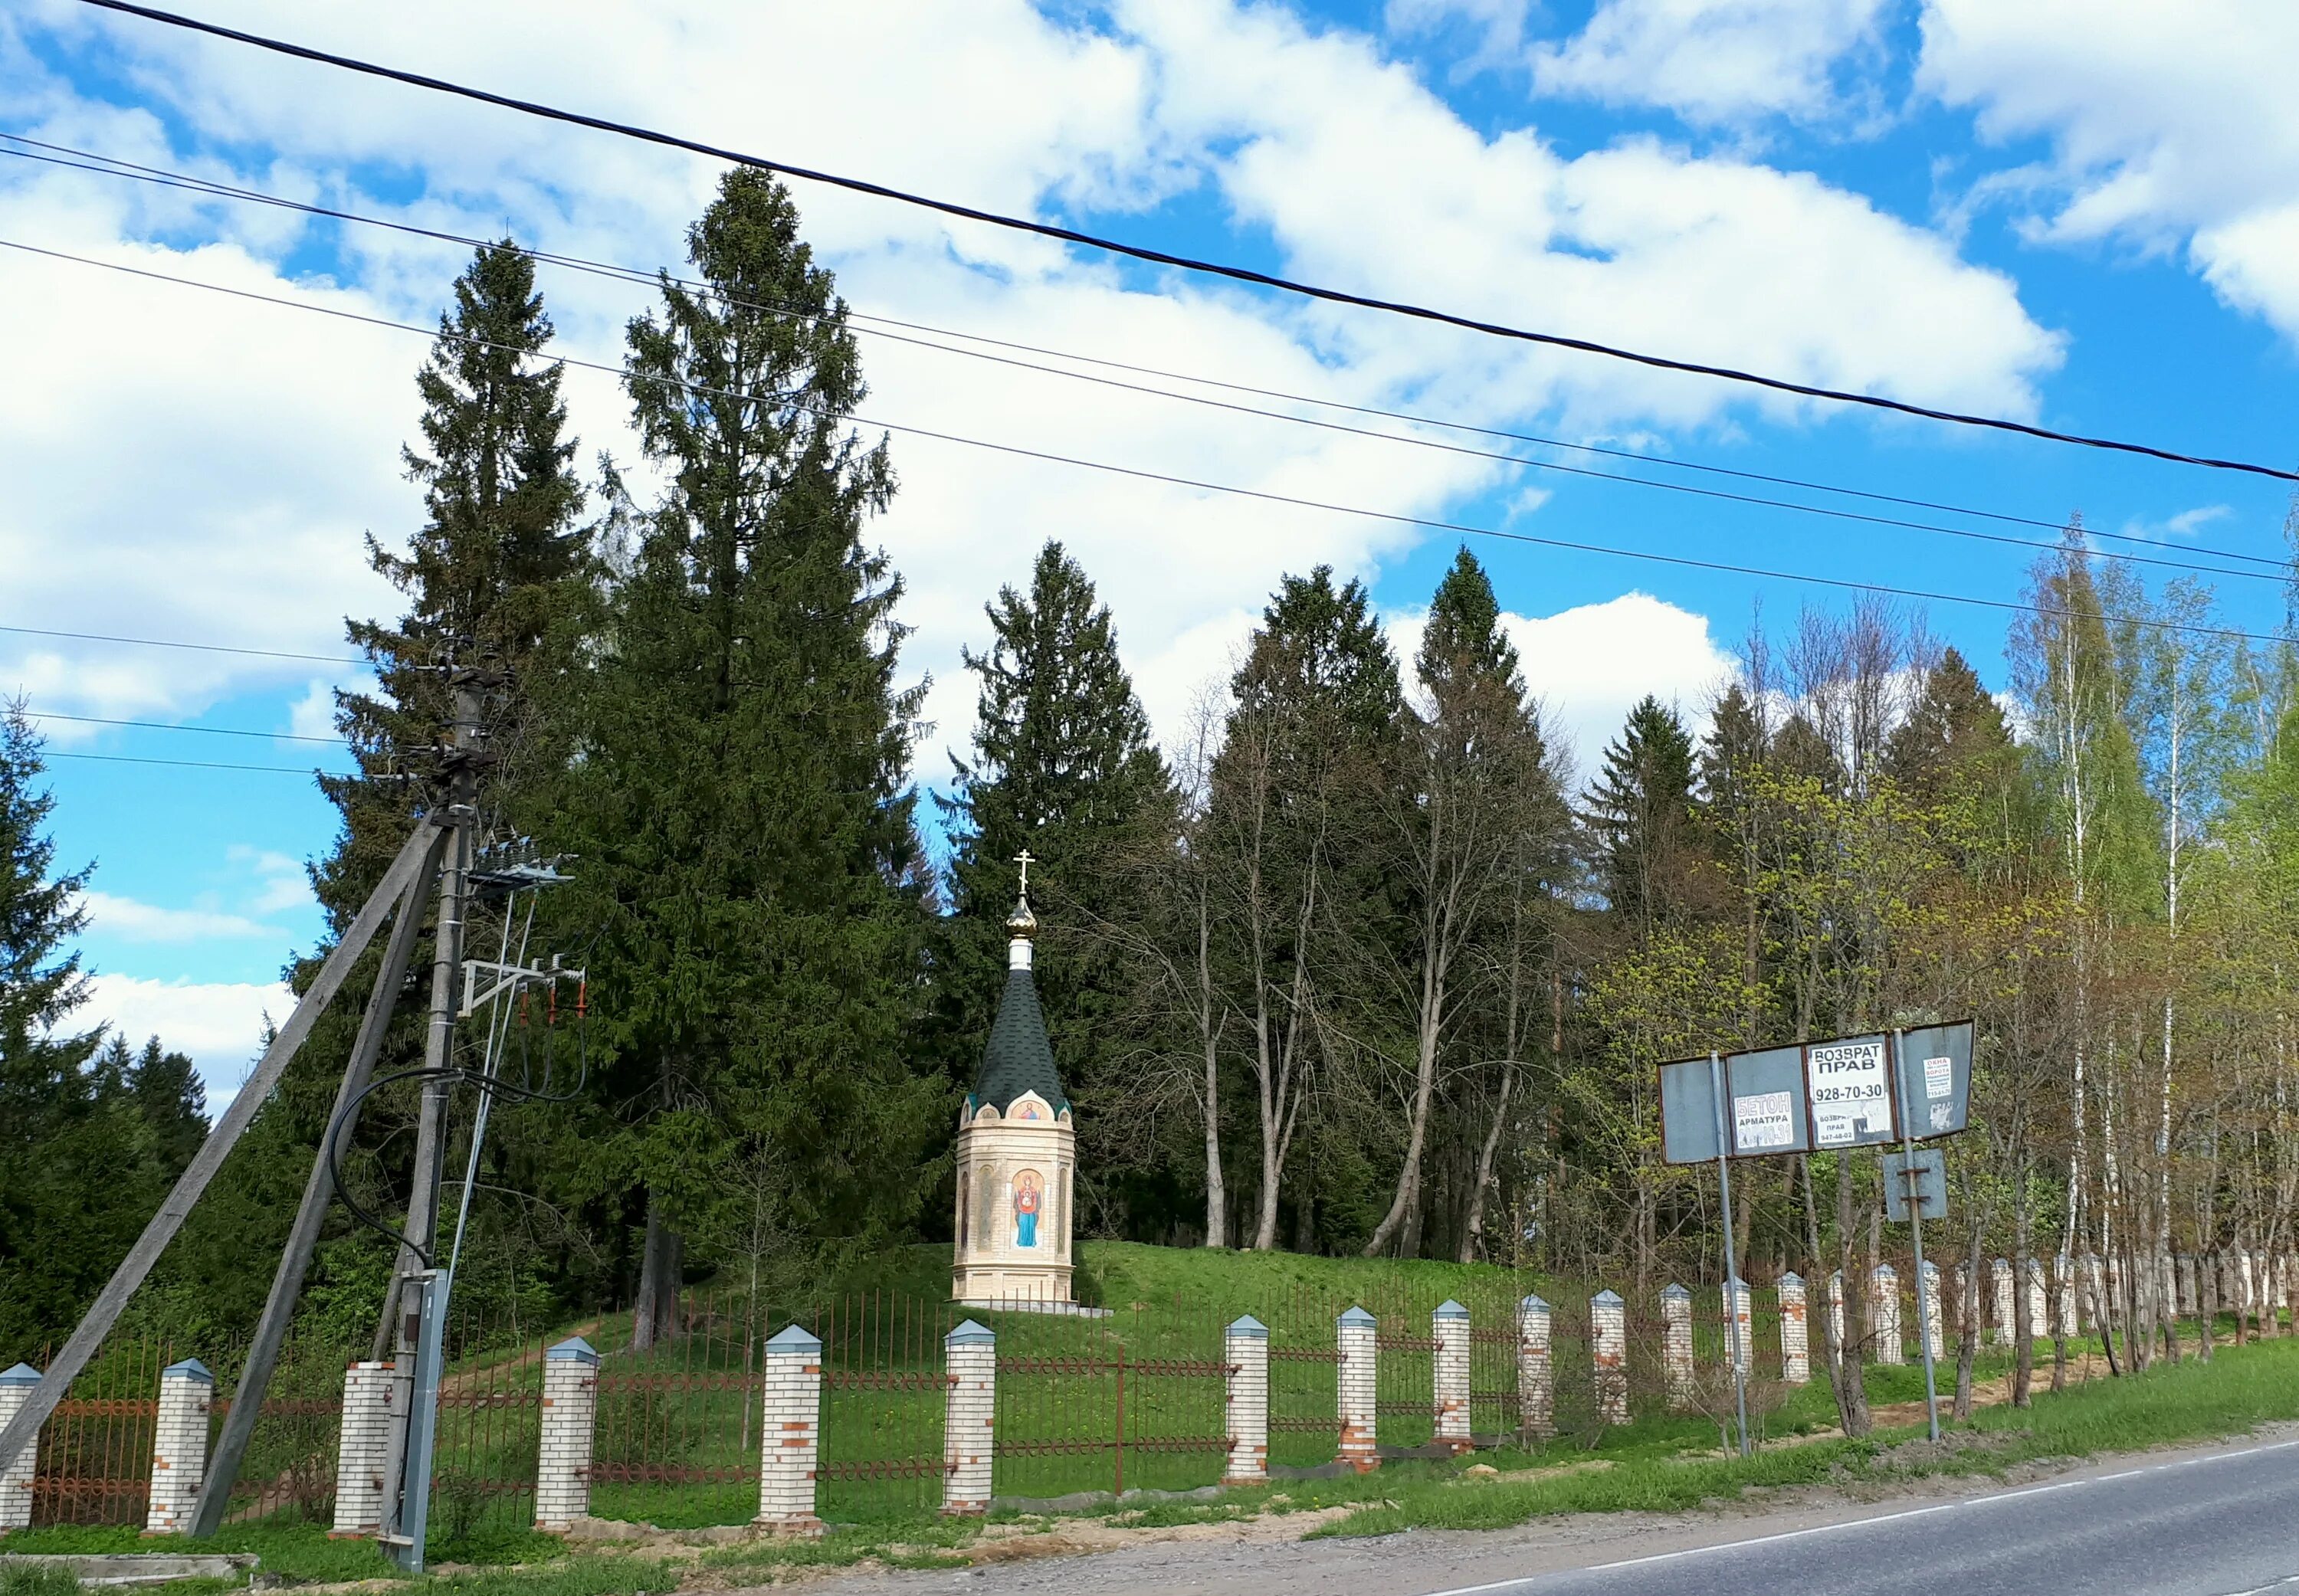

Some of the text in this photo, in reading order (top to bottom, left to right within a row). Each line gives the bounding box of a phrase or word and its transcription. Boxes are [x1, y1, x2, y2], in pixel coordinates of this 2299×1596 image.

[1815, 1045, 1880, 1063] ВОЗВРАТ
[1819, 1059, 1876, 1074] ПРАВ
[1815, 1083, 1882, 1101] 928-70-30
[1737, 1093, 1790, 1117] БЕТОН
[1739, 1115, 1789, 1126] АРМАТУРА
